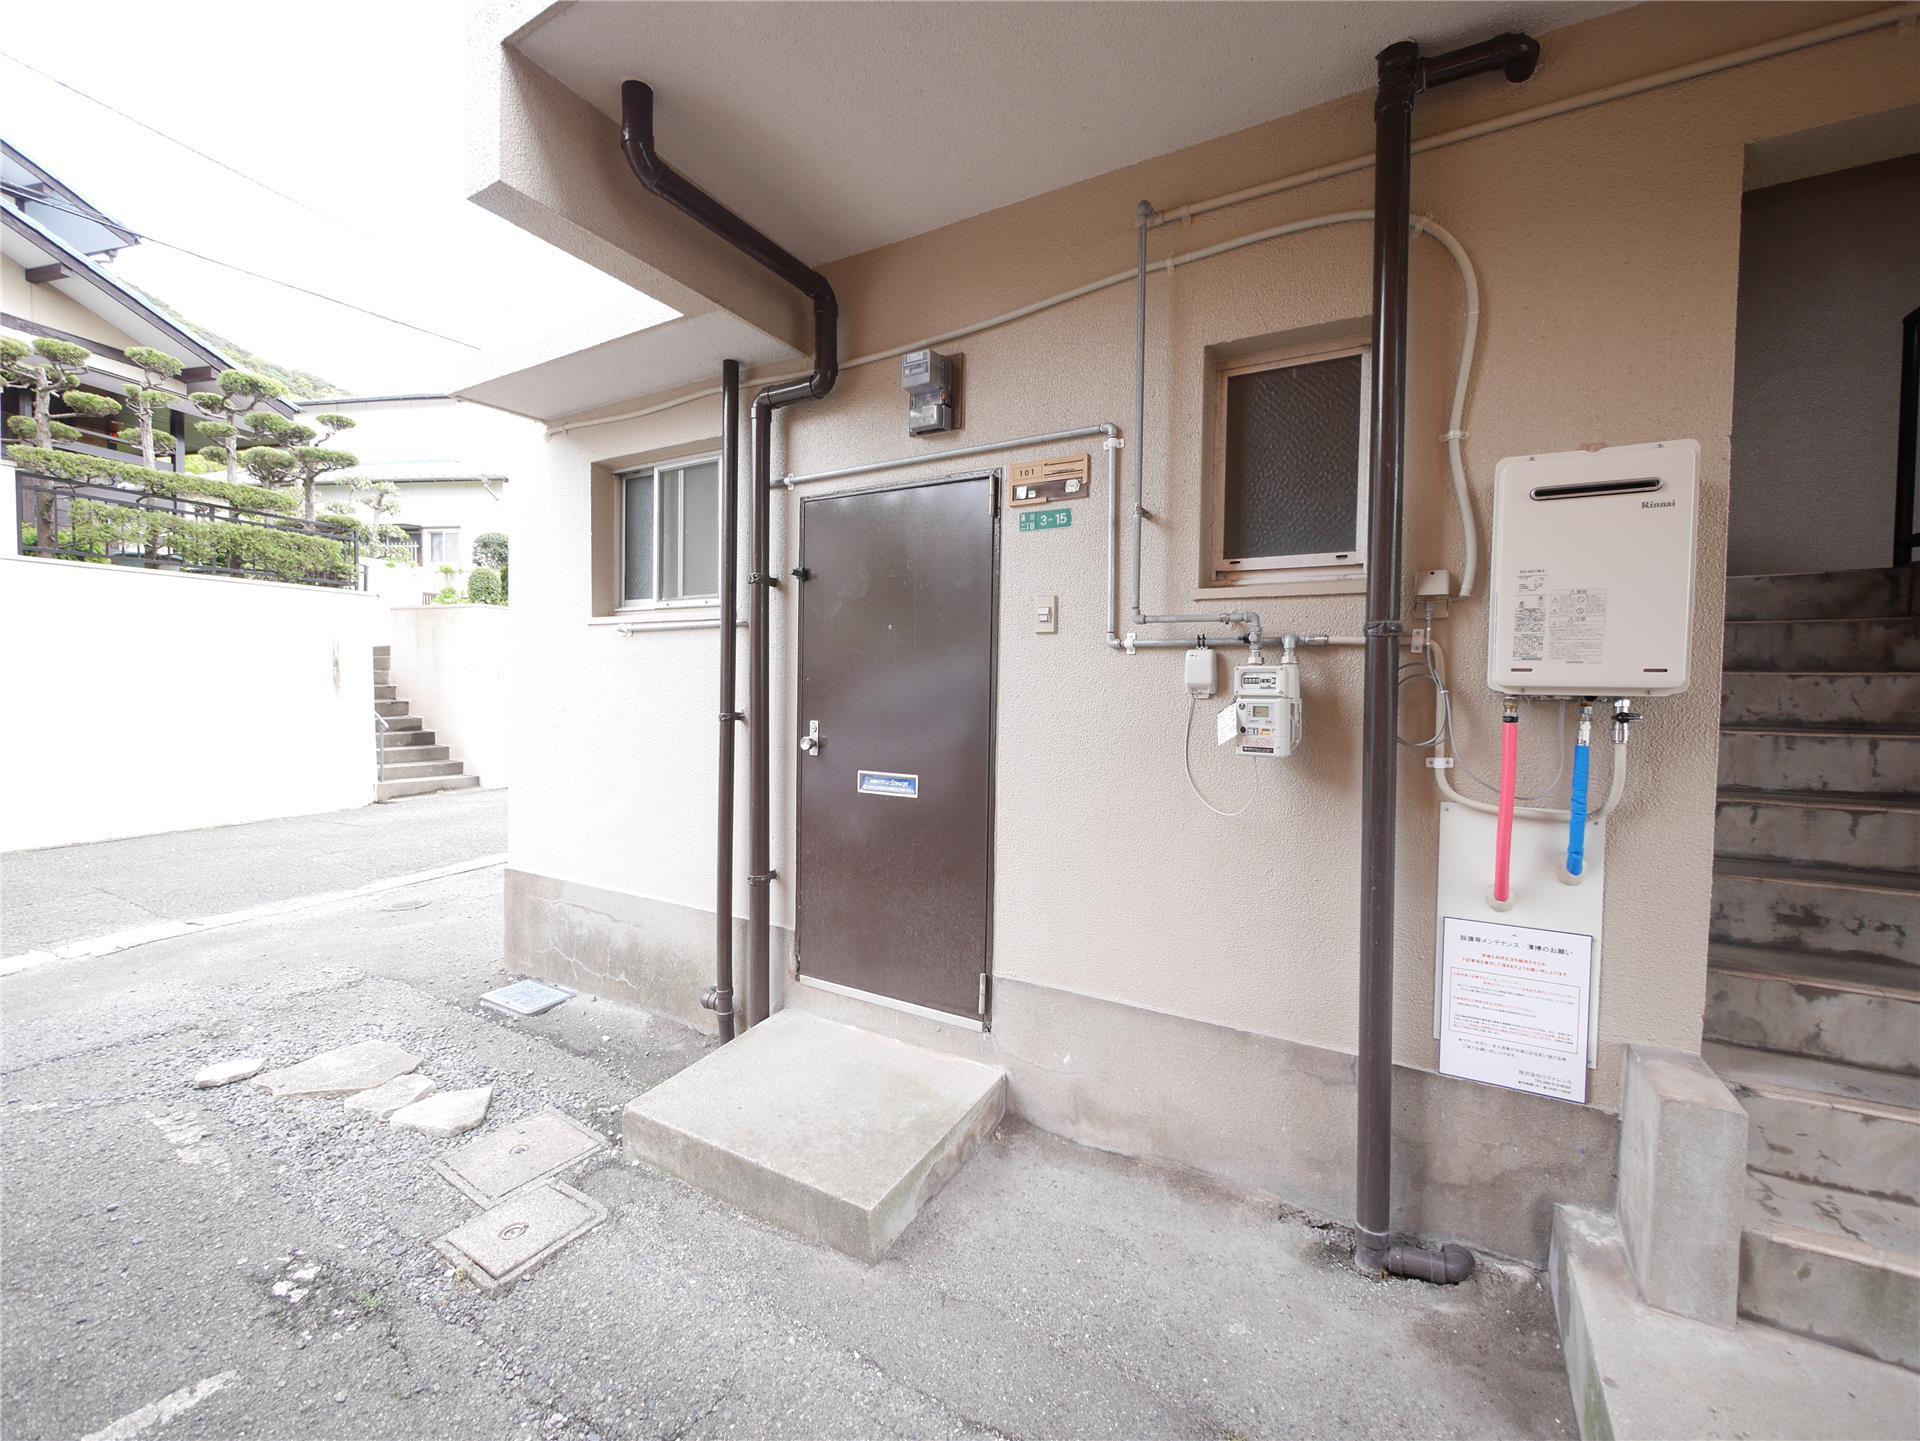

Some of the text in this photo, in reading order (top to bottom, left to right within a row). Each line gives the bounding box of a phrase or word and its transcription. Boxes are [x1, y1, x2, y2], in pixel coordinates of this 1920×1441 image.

[1019, 468, 1034, 477] 101
[1641, 499, 1675, 509] Rinnai
[1040, 512, 1067, 526] 3-15
